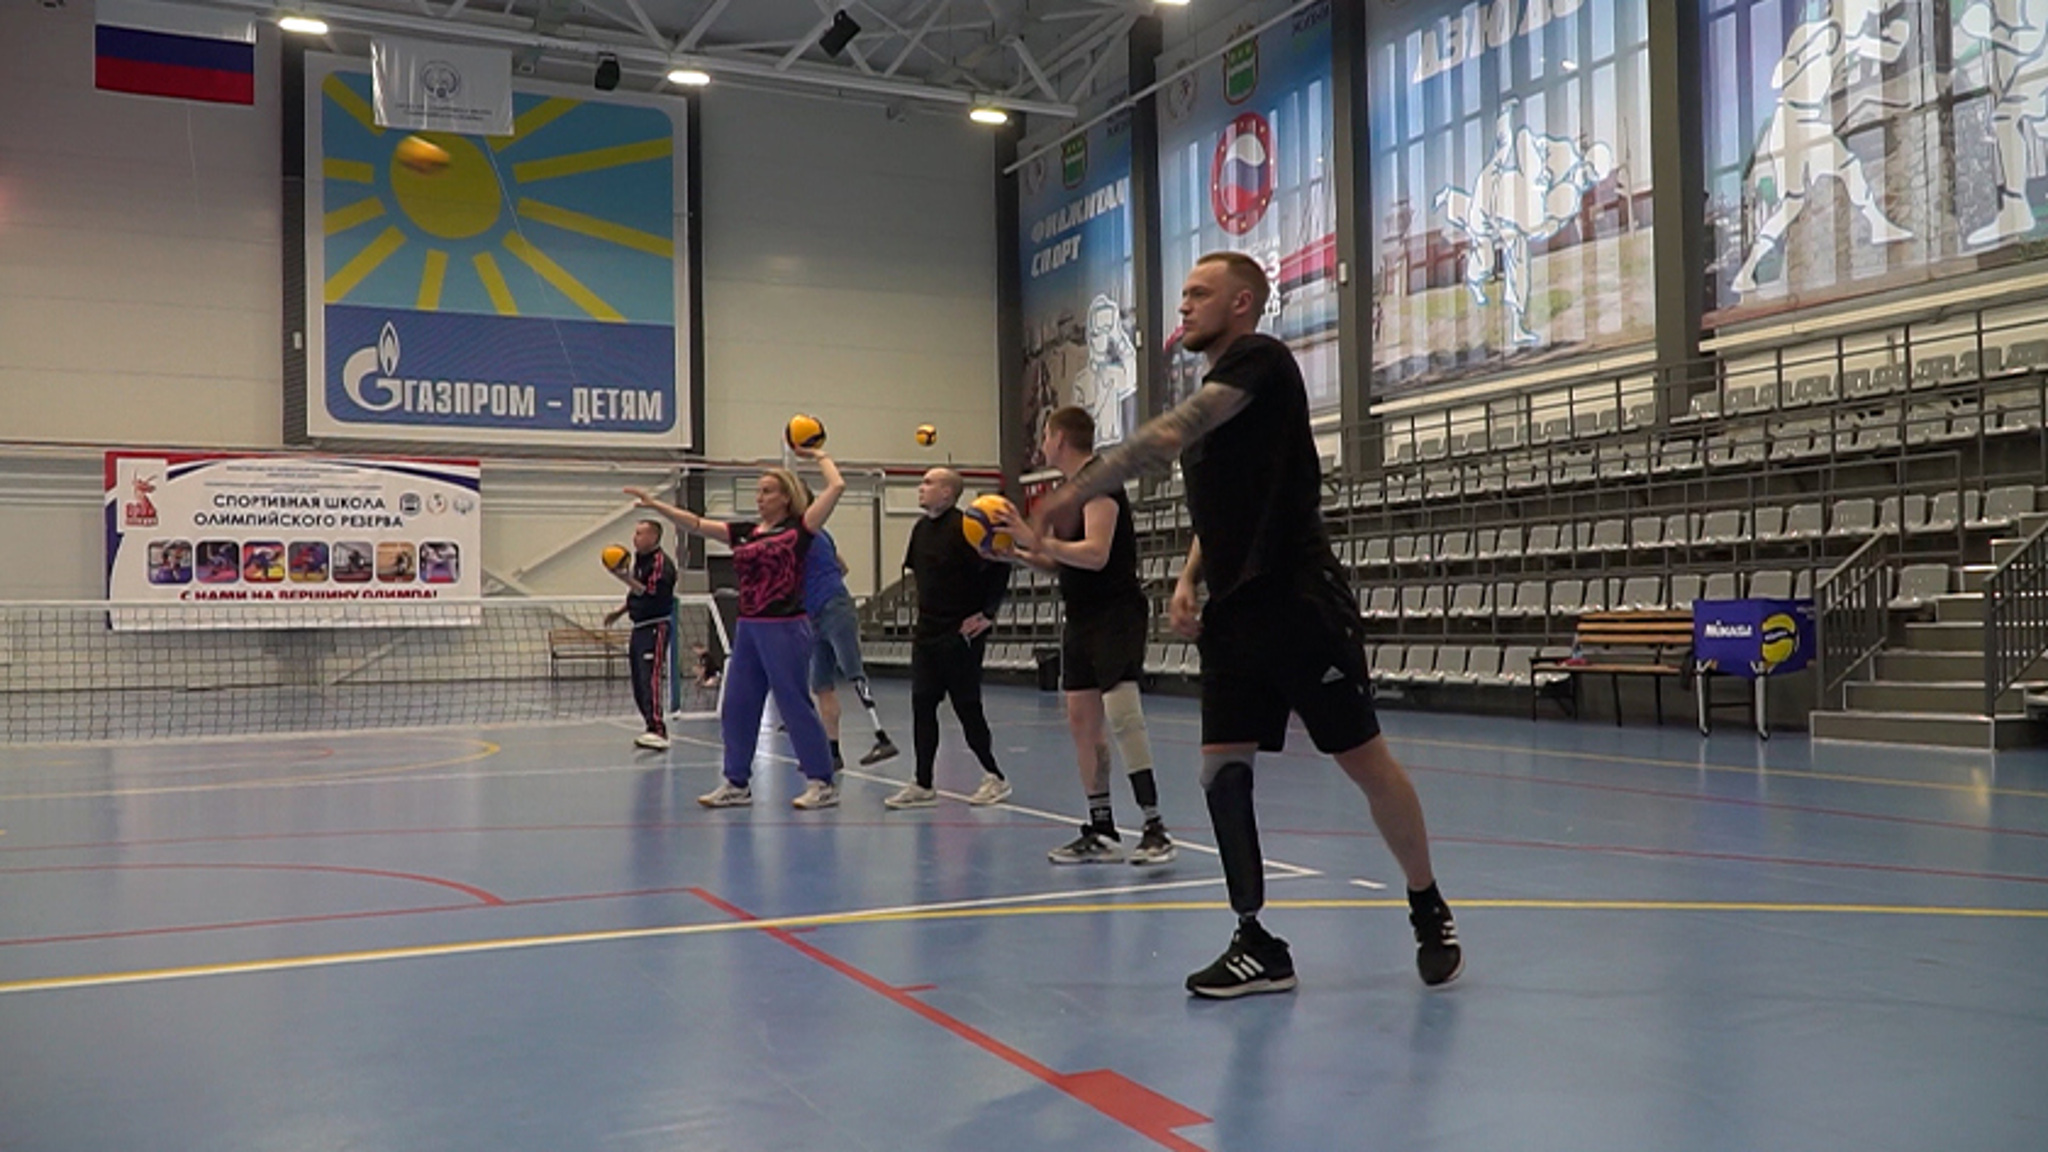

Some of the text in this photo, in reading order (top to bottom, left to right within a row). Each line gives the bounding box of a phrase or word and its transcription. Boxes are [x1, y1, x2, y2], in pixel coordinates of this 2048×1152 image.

[1031, 234, 1081, 278] СПОРТ
[403, 379, 536, 417] ГАЗПРОМ
[571, 387, 662, 424] ДЕТЯМ
[213, 495, 386, 510] СПОРТИВНАЯ ШКОЛА
[194, 511, 403, 528] ОЛИМПИЙСКОГО РЕЗЕРВА
[195, 590, 247, 600] НАМИ
[251, 590, 274, 600] НА
[279, 590, 359, 600] ВЕРШИНУ
[362, 590, 437, 599] ОЛИМПА!
